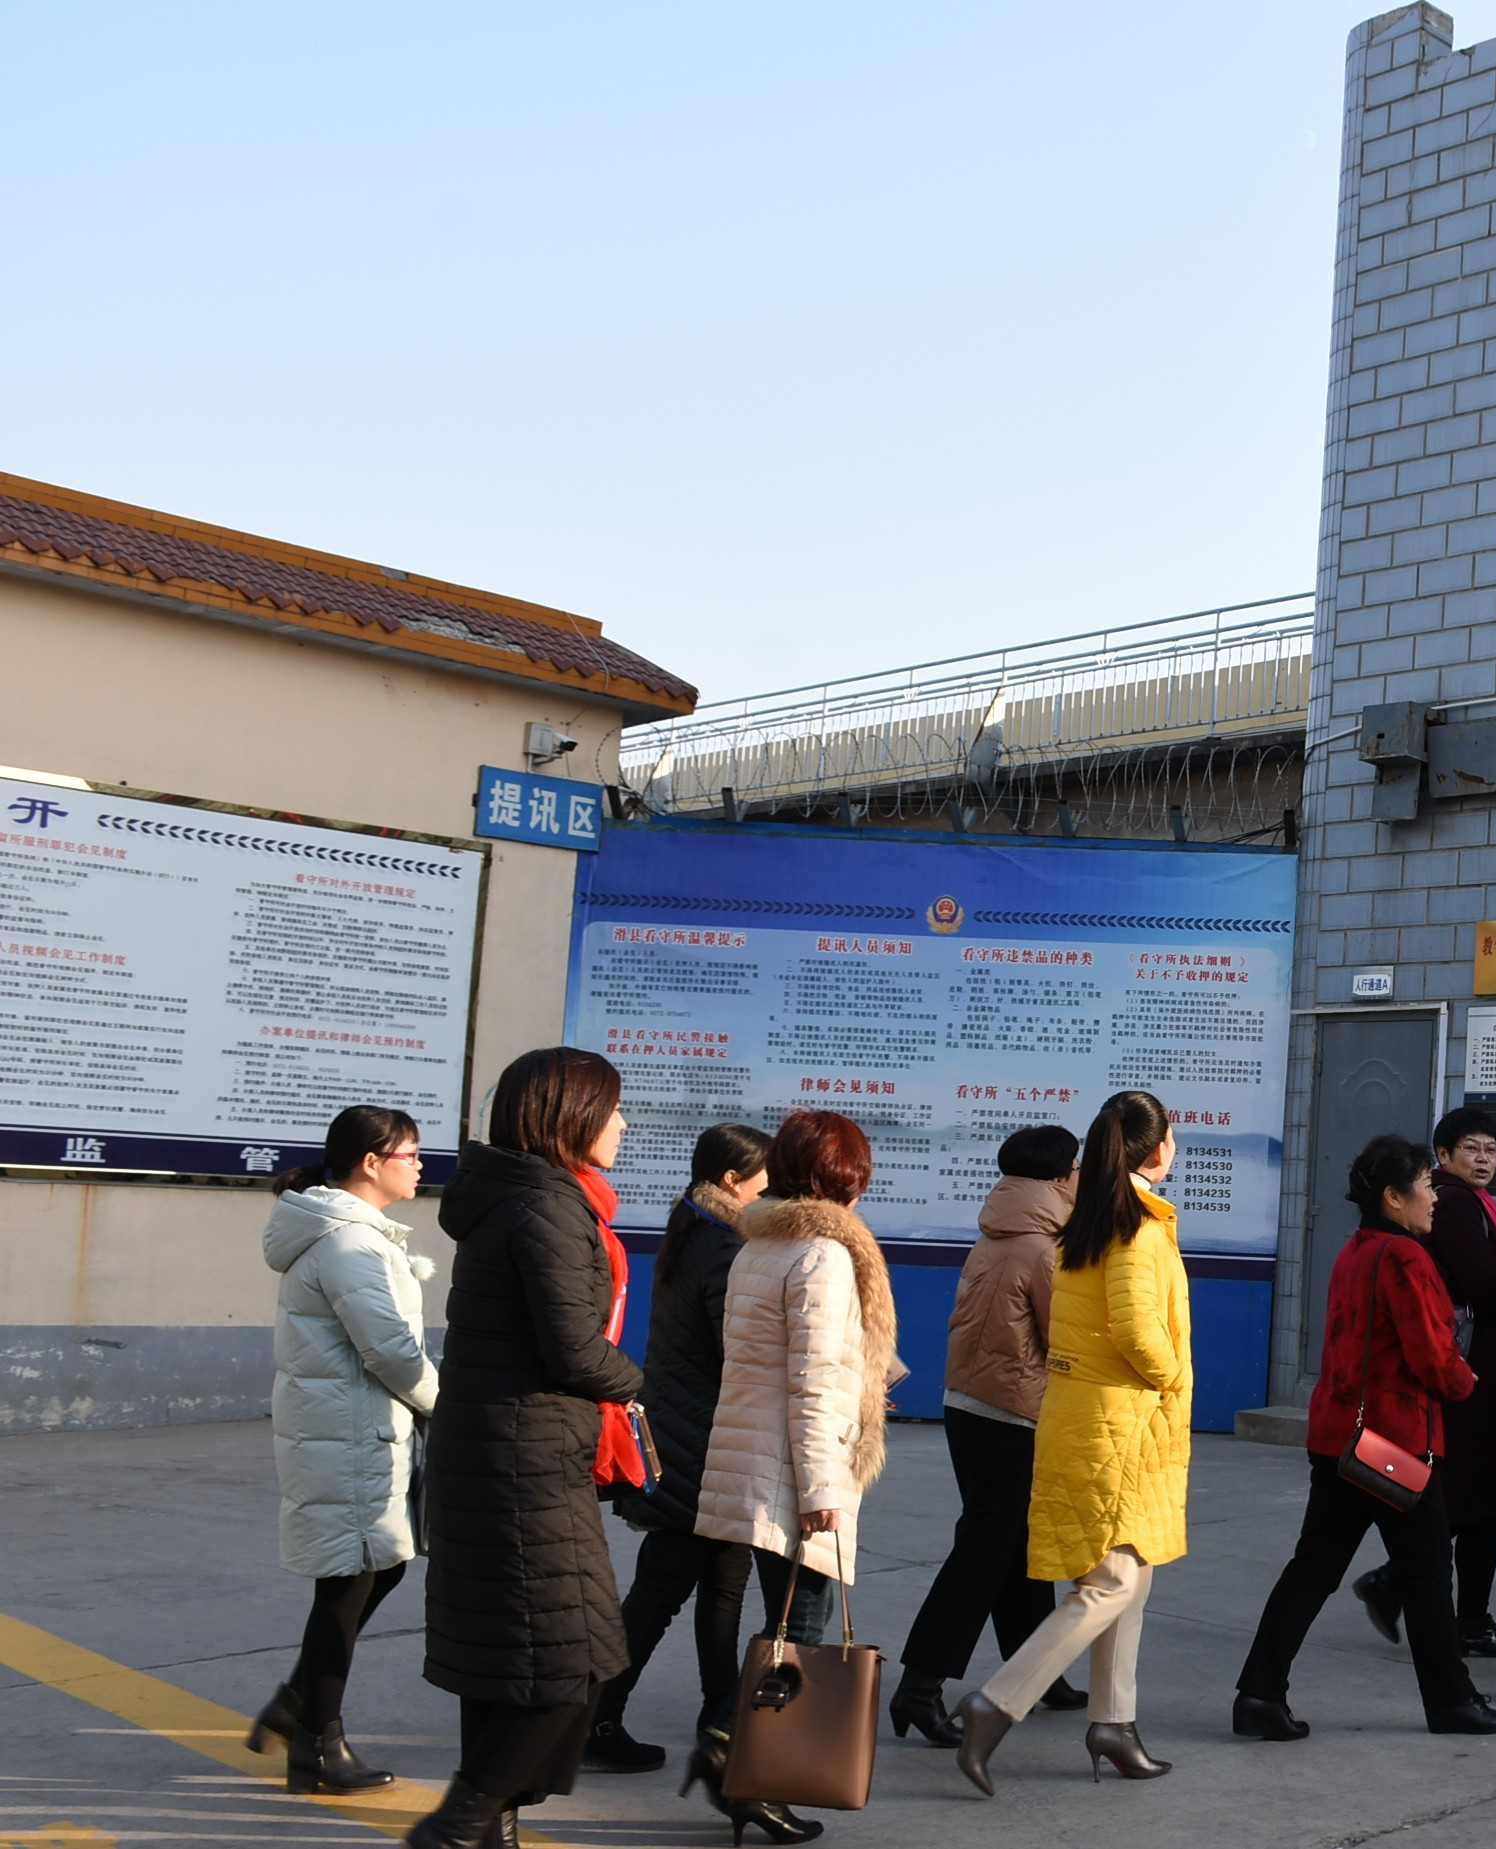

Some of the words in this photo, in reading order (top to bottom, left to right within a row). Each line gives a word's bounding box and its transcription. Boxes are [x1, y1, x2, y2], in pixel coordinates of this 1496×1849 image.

[8, 797, 69, 828] 开
[490, 779, 597, 839] 提讯区
[295, 873, 416, 899] 看守所对外开放管理规定
[614, 928, 747, 947] 滑县看守所温馨提示
[818, 938, 913, 954] 提讯人员须知
[962, 947, 1093, 965] 看守所违禁品的种类
[1129, 953, 1246, 967] 《看守所执法细则》
[1135, 968, 1248, 983] 关于不予收押的规定
[1355, 978, 1388, 991] 人行通道A
[260, 1025, 426, 1050] 办案单位提讯和律师会见预约制度
[608, 1029, 729, 1043] 滑县看守所民警接触
[606, 1043, 728, 1058] 联系在押人员家属规定
[800, 1077, 895, 1094] 律师会见须知
[956, 1084, 1079, 1102] 看守所“五个严禁”
[1168, 1110, 1231, 1125] 值班电话
[60, 1138, 106, 1163] 监
[240, 1146, 280, 1172] 管
[1186, 1147, 1232, 1157] 8134531
[1185, 1161, 1233, 1171] 8134530
[1185, 1175, 1232, 1185] 8134532
[1184, 1188, 1231, 1198] 8134235
[1184, 1202, 1231, 1212] 8134539
